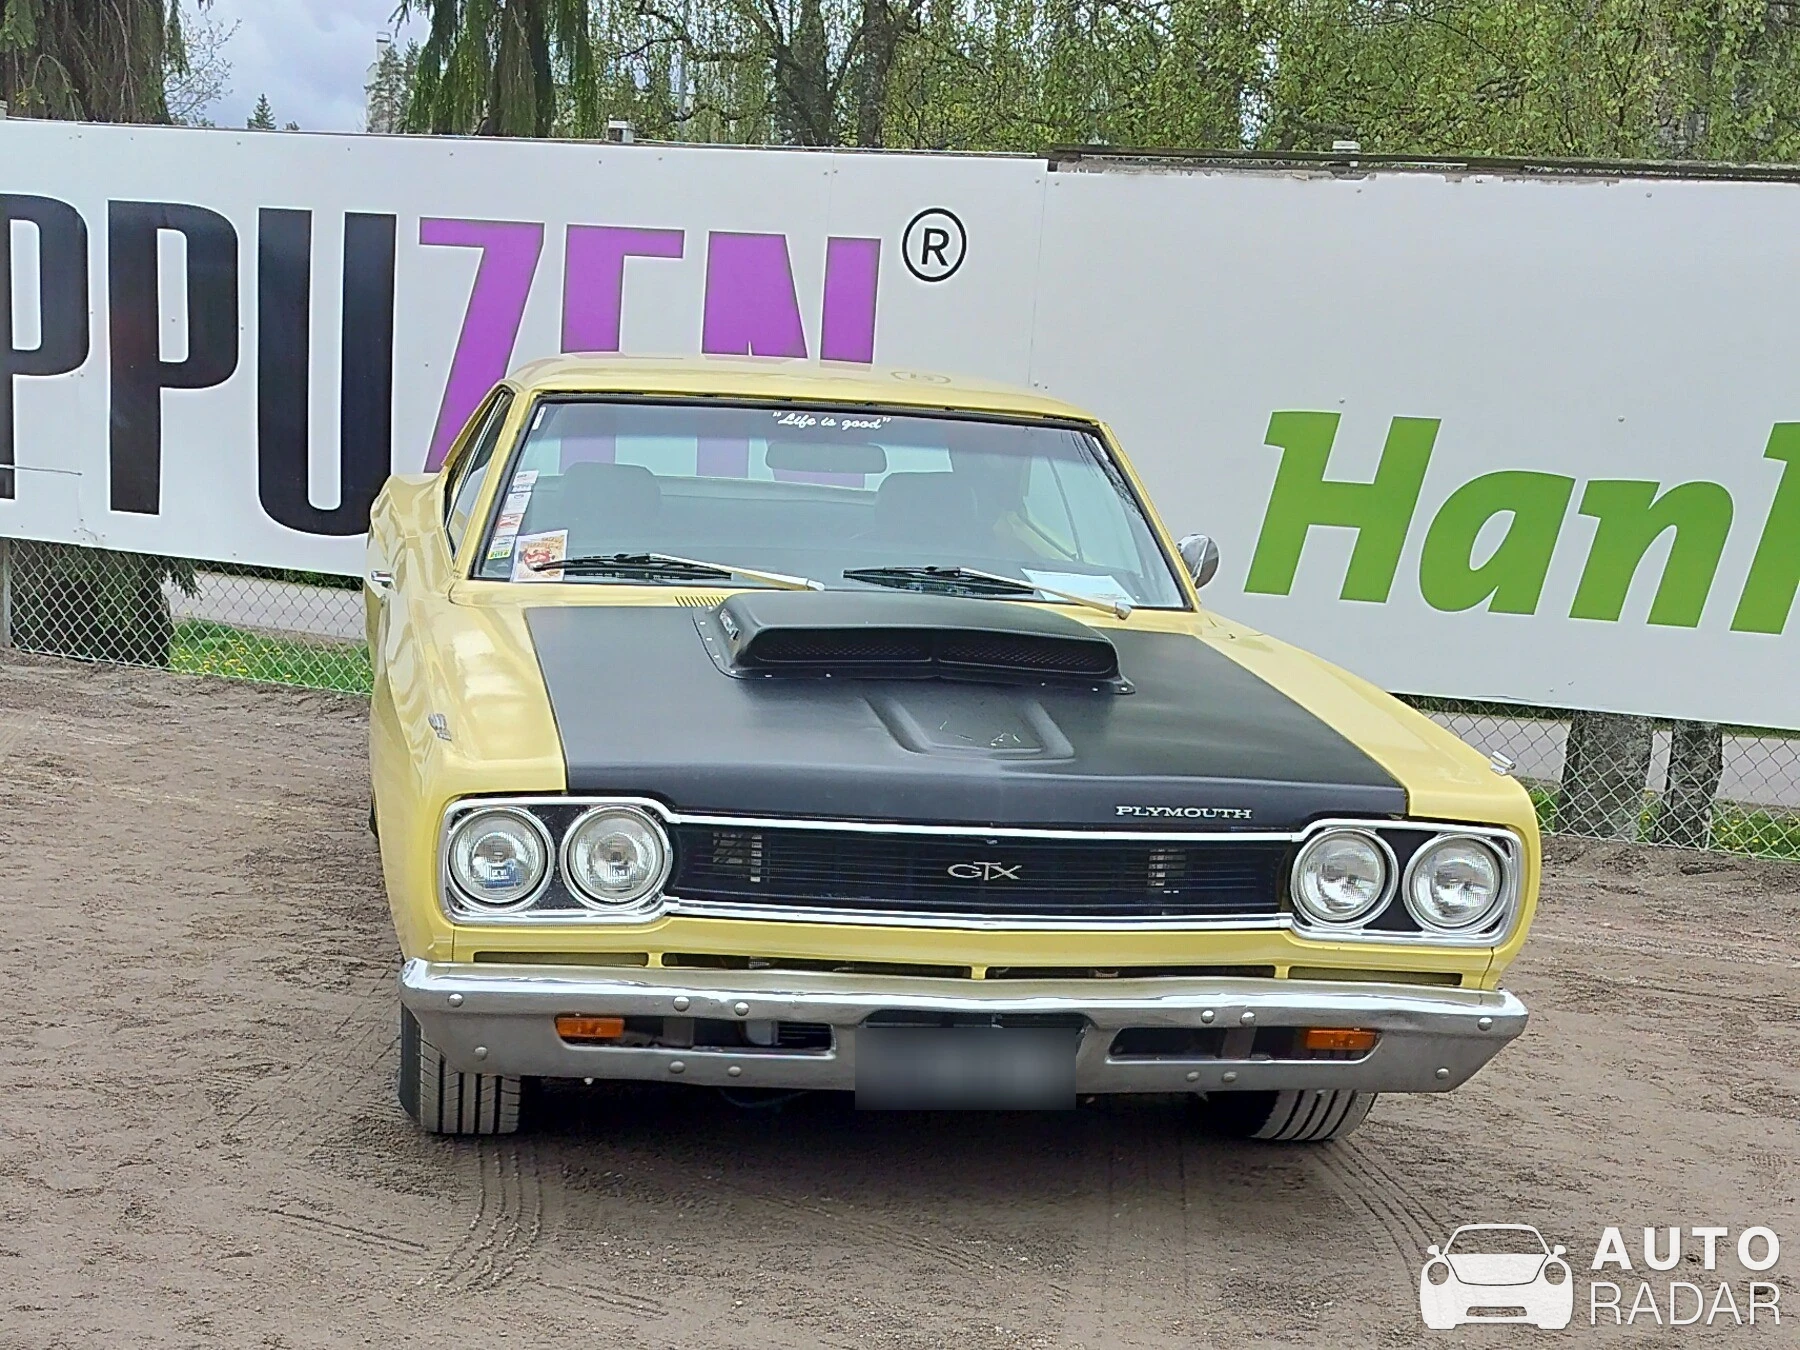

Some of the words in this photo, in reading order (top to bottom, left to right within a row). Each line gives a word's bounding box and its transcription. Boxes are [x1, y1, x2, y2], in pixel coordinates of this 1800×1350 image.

[820, 416, 837, 426] is
[1115, 805, 1253, 819] PLYMOUTH
[947, 861, 1022, 881] GTX
